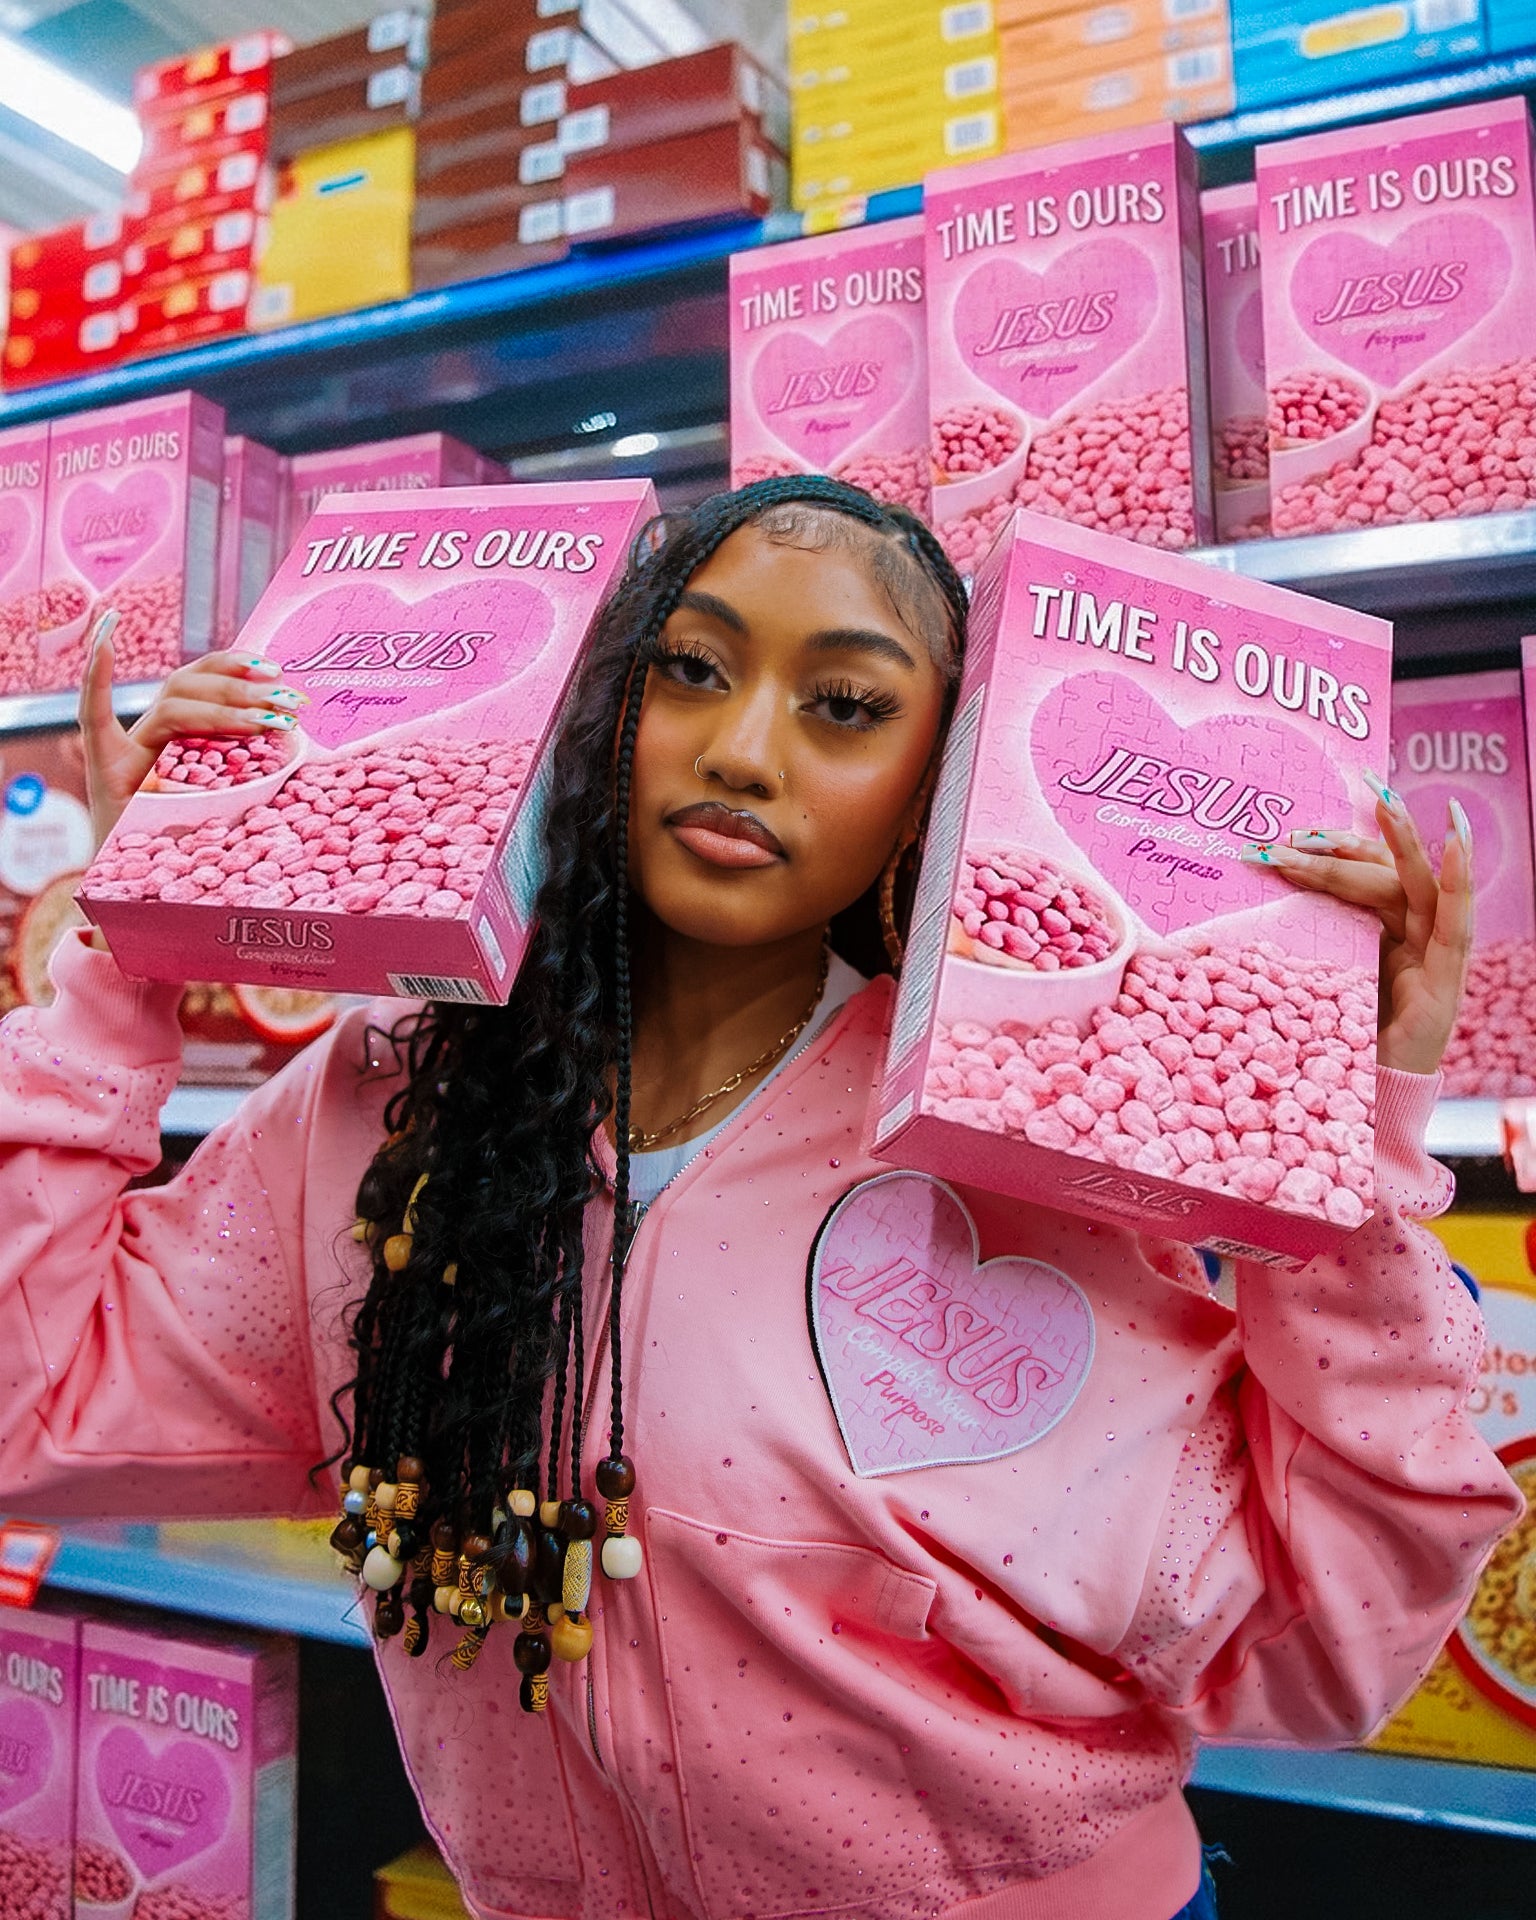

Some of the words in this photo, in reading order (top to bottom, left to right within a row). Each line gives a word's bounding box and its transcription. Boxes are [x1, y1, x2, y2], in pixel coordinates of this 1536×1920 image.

[936, 203, 1017, 261] TIME
[1027, 196, 1060, 238] IS
[1067, 180, 1165, 231] OURS
[1270, 176, 1358, 233] TIME
[1369, 169, 1403, 212] IS
[1412, 155, 1518, 204] OURS
[739, 284, 805, 332] TIME
[812, 276, 839, 313] IS
[845, 267, 923, 307] OURS
[973, 290, 1119, 357] JESUS
[1314, 261, 1468, 327] JESUS
[301, 531, 418, 577] TIME
[418, 530, 469, 569] IS
[472, 529, 603, 573] OURS
[281, 630, 496, 672] JESUS
[1028, 583, 1158, 664] TIME
[1171, 620, 1222, 683] IS
[1233, 642, 1371, 741] OURS
[1407, 730, 1510, 775] OURS
[1058, 746, 1295, 843] JESUS
[216, 916, 335, 950] JESUS
[820, 1256, 1065, 1418] JESUS
[847, 1324, 941, 1399] Completes
[936, 1390, 983, 1430] Your
[863, 1369, 946, 1438] Purpose
[7, 1652, 63, 1706] OURS
[88, 1673, 142, 1718] TIME
[146, 1685, 170, 1725] IS
[174, 1692, 240, 1751] OURS
